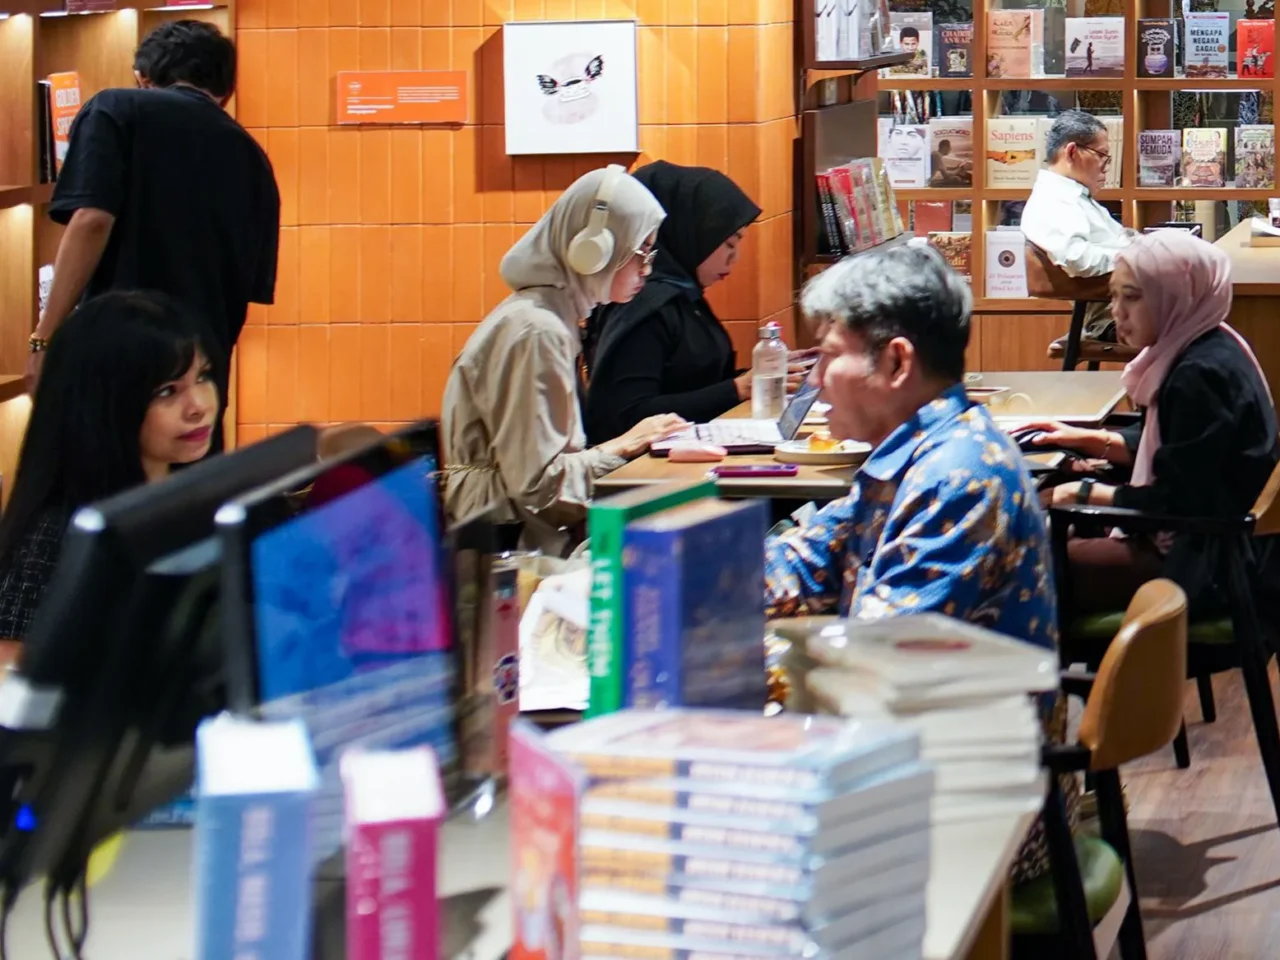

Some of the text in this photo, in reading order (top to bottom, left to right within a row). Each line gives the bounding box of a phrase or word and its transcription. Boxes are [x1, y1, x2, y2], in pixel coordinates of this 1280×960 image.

[991, 130, 1034, 143] Sapiens
[1140, 135, 1173, 144] SUMPAH
[1140, 145, 1173, 155] PEMUDA
